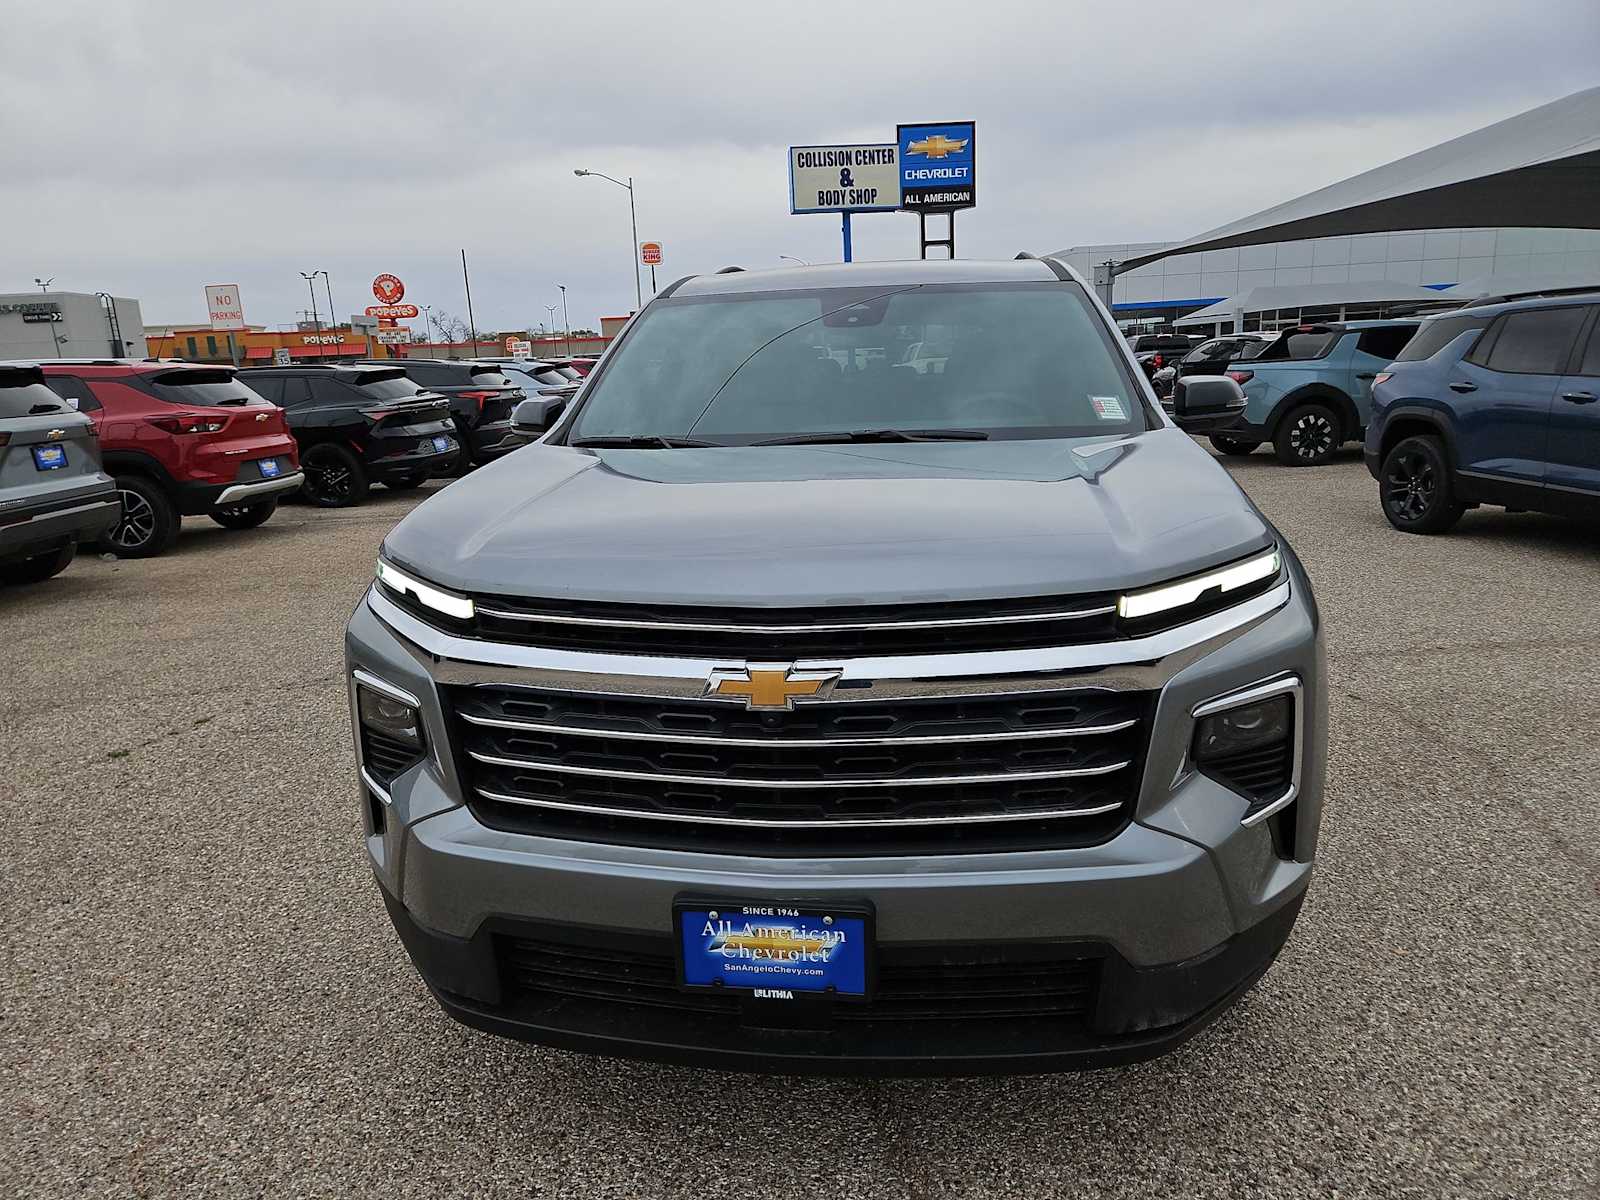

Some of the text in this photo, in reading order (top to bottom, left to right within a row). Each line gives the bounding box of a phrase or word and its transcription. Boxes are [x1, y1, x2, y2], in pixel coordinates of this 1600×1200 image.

[797, 148, 895, 168] COLLISION CENTER
[839, 167, 855, 188] &
[904, 167, 969, 180] CHEVROLET
[818, 188, 878, 206] BODY SHOP
[904, 191, 970, 204] ALL AMERICAN
[215, 295, 232, 305] NO
[210, 310, 241, 321] PARKING
[742, 906, 800, 917] SINCE 1946
[701, 920, 846, 943] All American
[720, 942, 830, 963] Chevrolet
[724, 963, 824, 976] SanAngeloChevy.com
[763, 989, 794, 999] LITHIA
